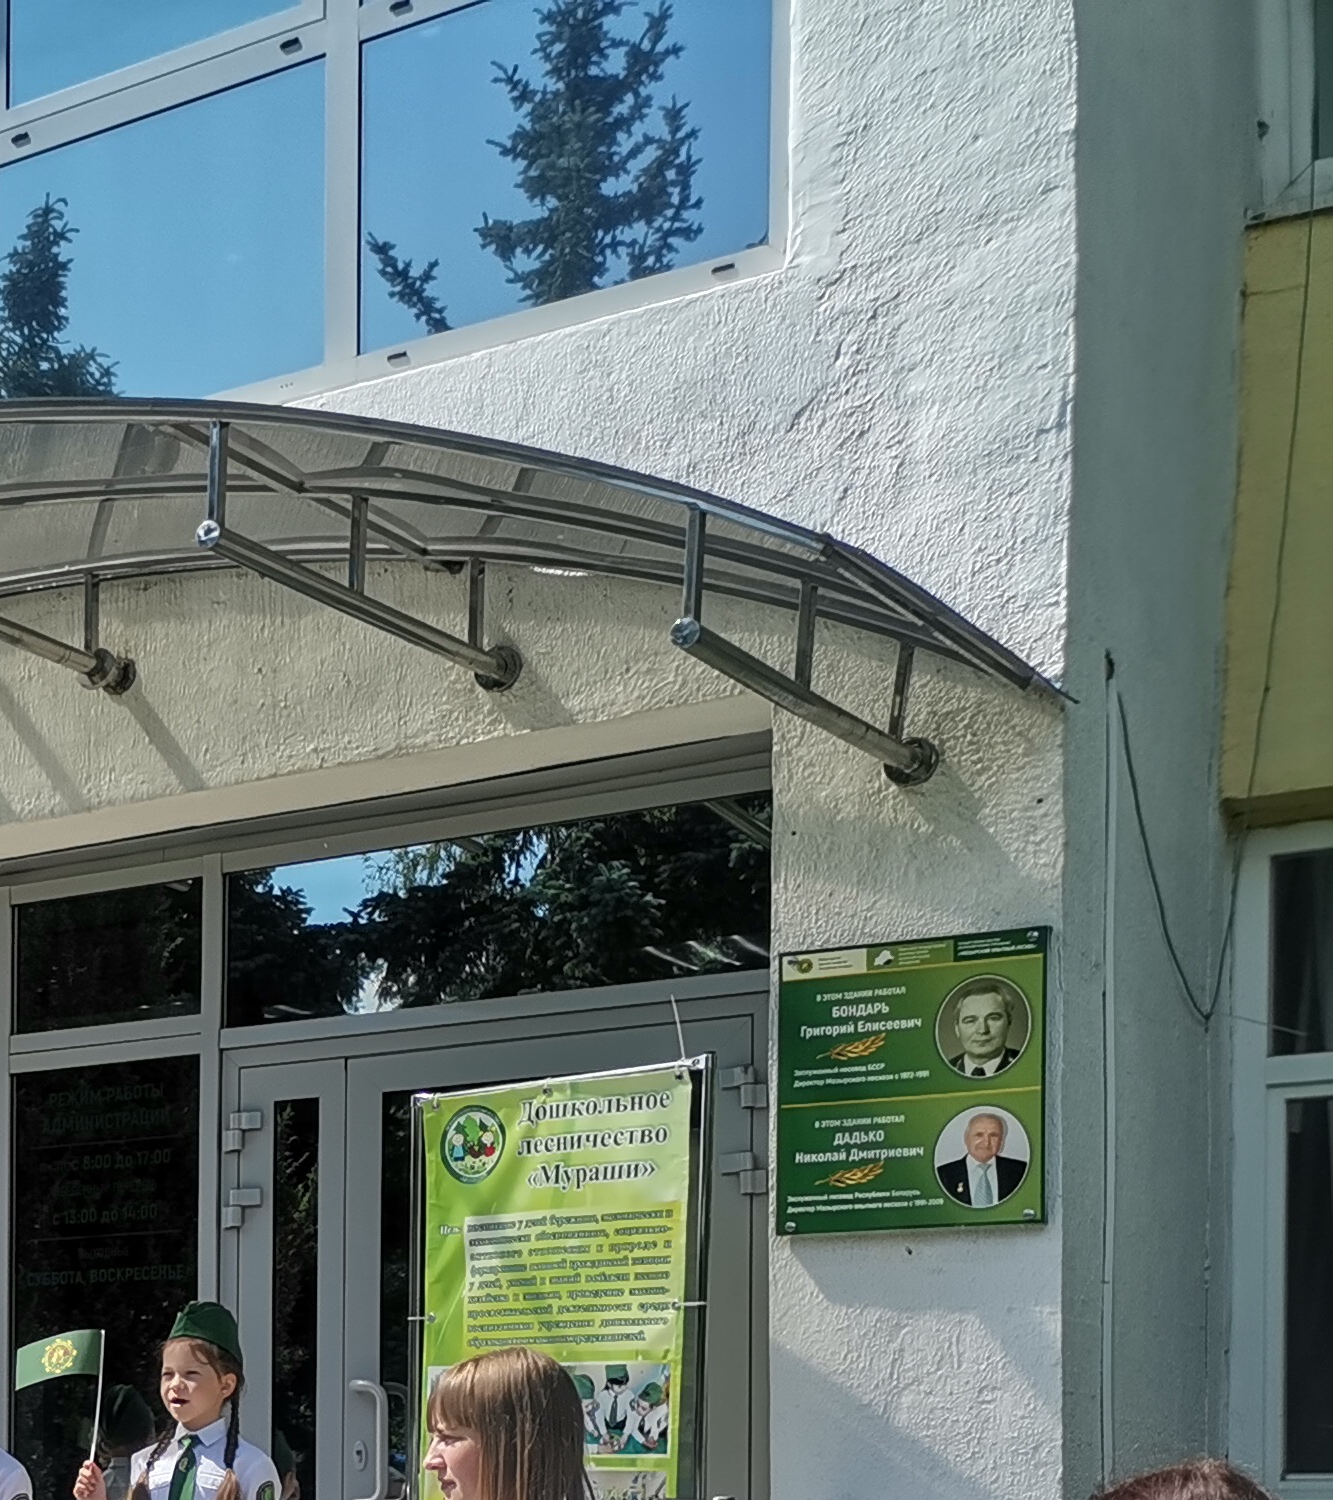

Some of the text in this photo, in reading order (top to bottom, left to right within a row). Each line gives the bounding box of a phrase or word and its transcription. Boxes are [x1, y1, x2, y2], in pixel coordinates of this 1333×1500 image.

[874, 986, 906, 996] РАБОТАЛ
[832, 1002, 889, 1018] БОНДАРЬ
[800, 1018, 921, 1039] Григорий Елисеевич
[868, 1063, 885, 1071] БССР
[107, 1082, 164, 1102] РАБОТЫ
[517, 1091, 671, 1127] Дошкольное
[42, 1105, 171, 1134] АДМИНИСТРАЦИИ
[873, 1115, 905, 1124] РАБОТАЛ
[517, 1127, 668, 1156] лесничество
[833, 1130, 884, 1146] ДАДЬКО
[83, 1154, 111, 1170] 8:00
[137, 1149, 171, 1165] 17:00
[795, 1147, 924, 1163] Николай Дмитриевич
[527, 1162, 656, 1190] «Мураши»
[53, 1204, 158, 1225] с 13:00 до 14:00
[90, 1264, 184, 1283] ВОСКРЕСЕНЬЕ
